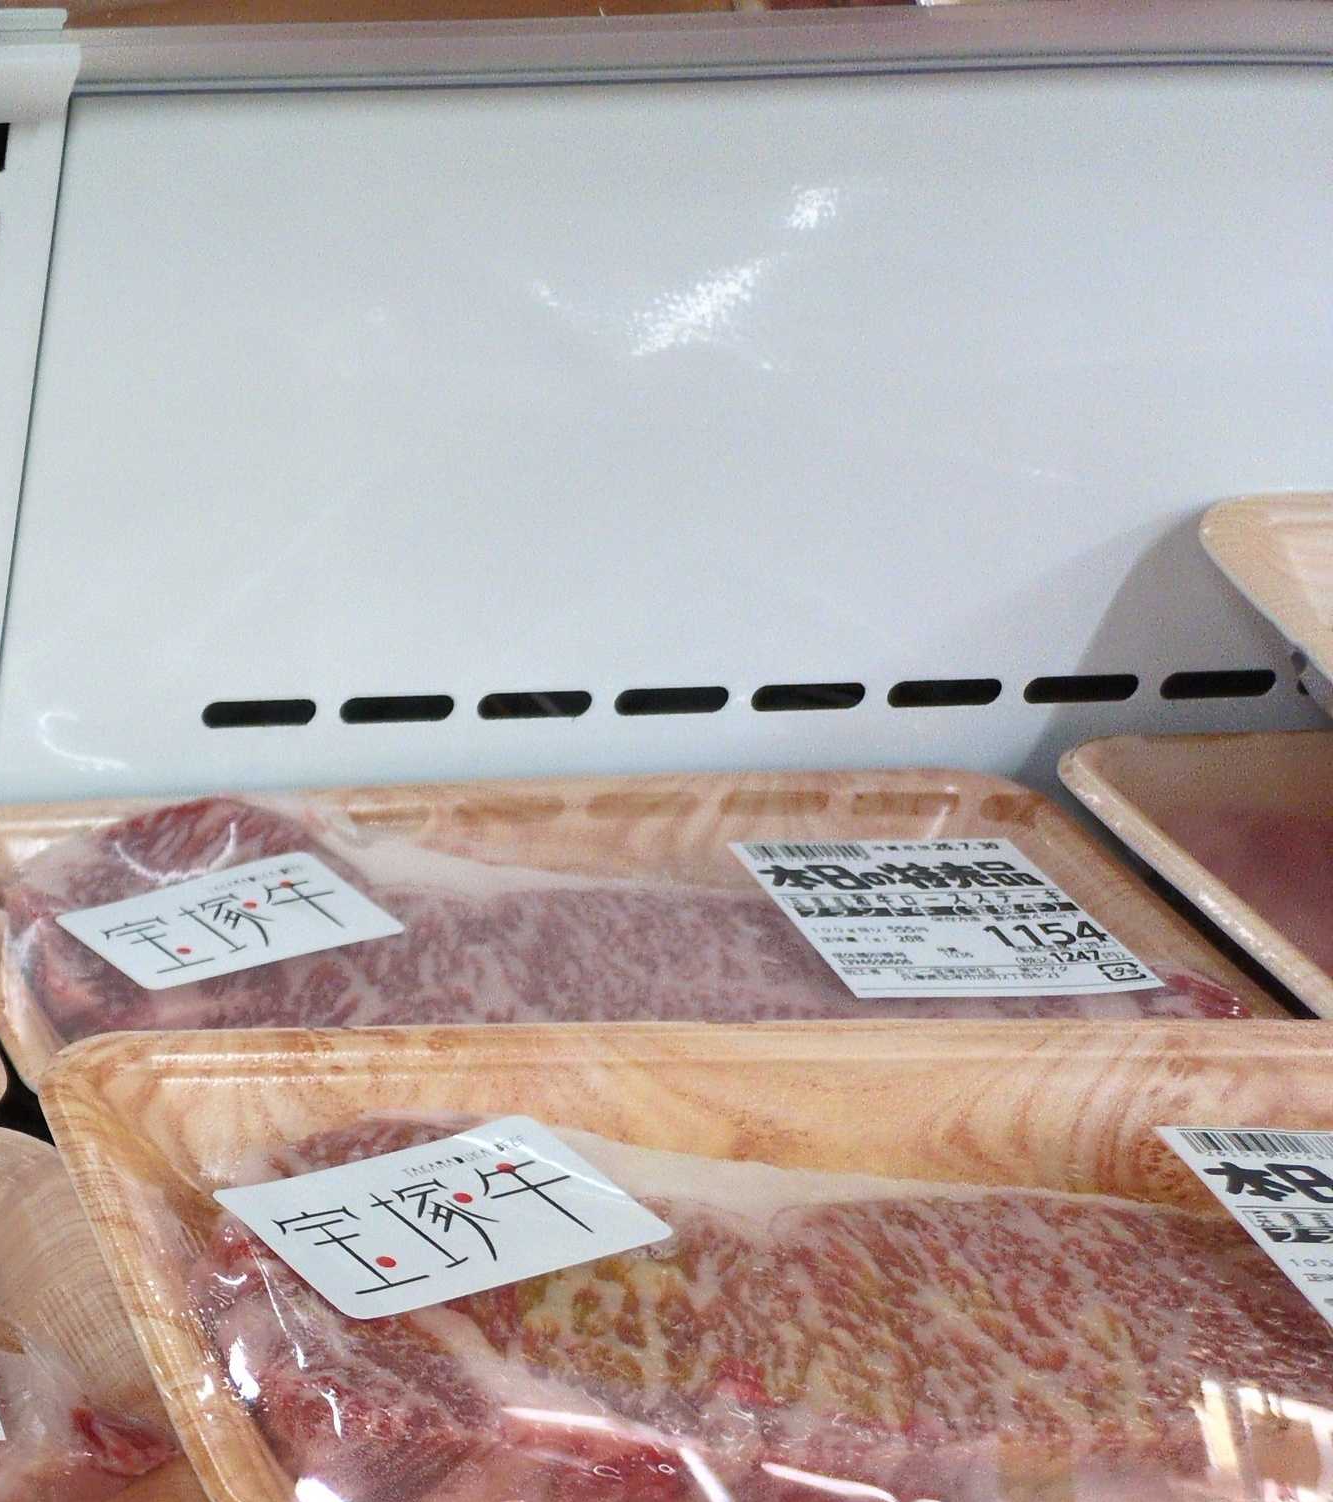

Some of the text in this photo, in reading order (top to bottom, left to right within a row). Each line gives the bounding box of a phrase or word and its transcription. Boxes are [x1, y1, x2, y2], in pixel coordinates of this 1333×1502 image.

[758, 860, 1046, 891] 本日の特売品
[102, 879, 346, 975] 宝塚牛
[982, 920, 1108, 948] 1154
[271, 1160, 594, 1295] 宝塚牛
